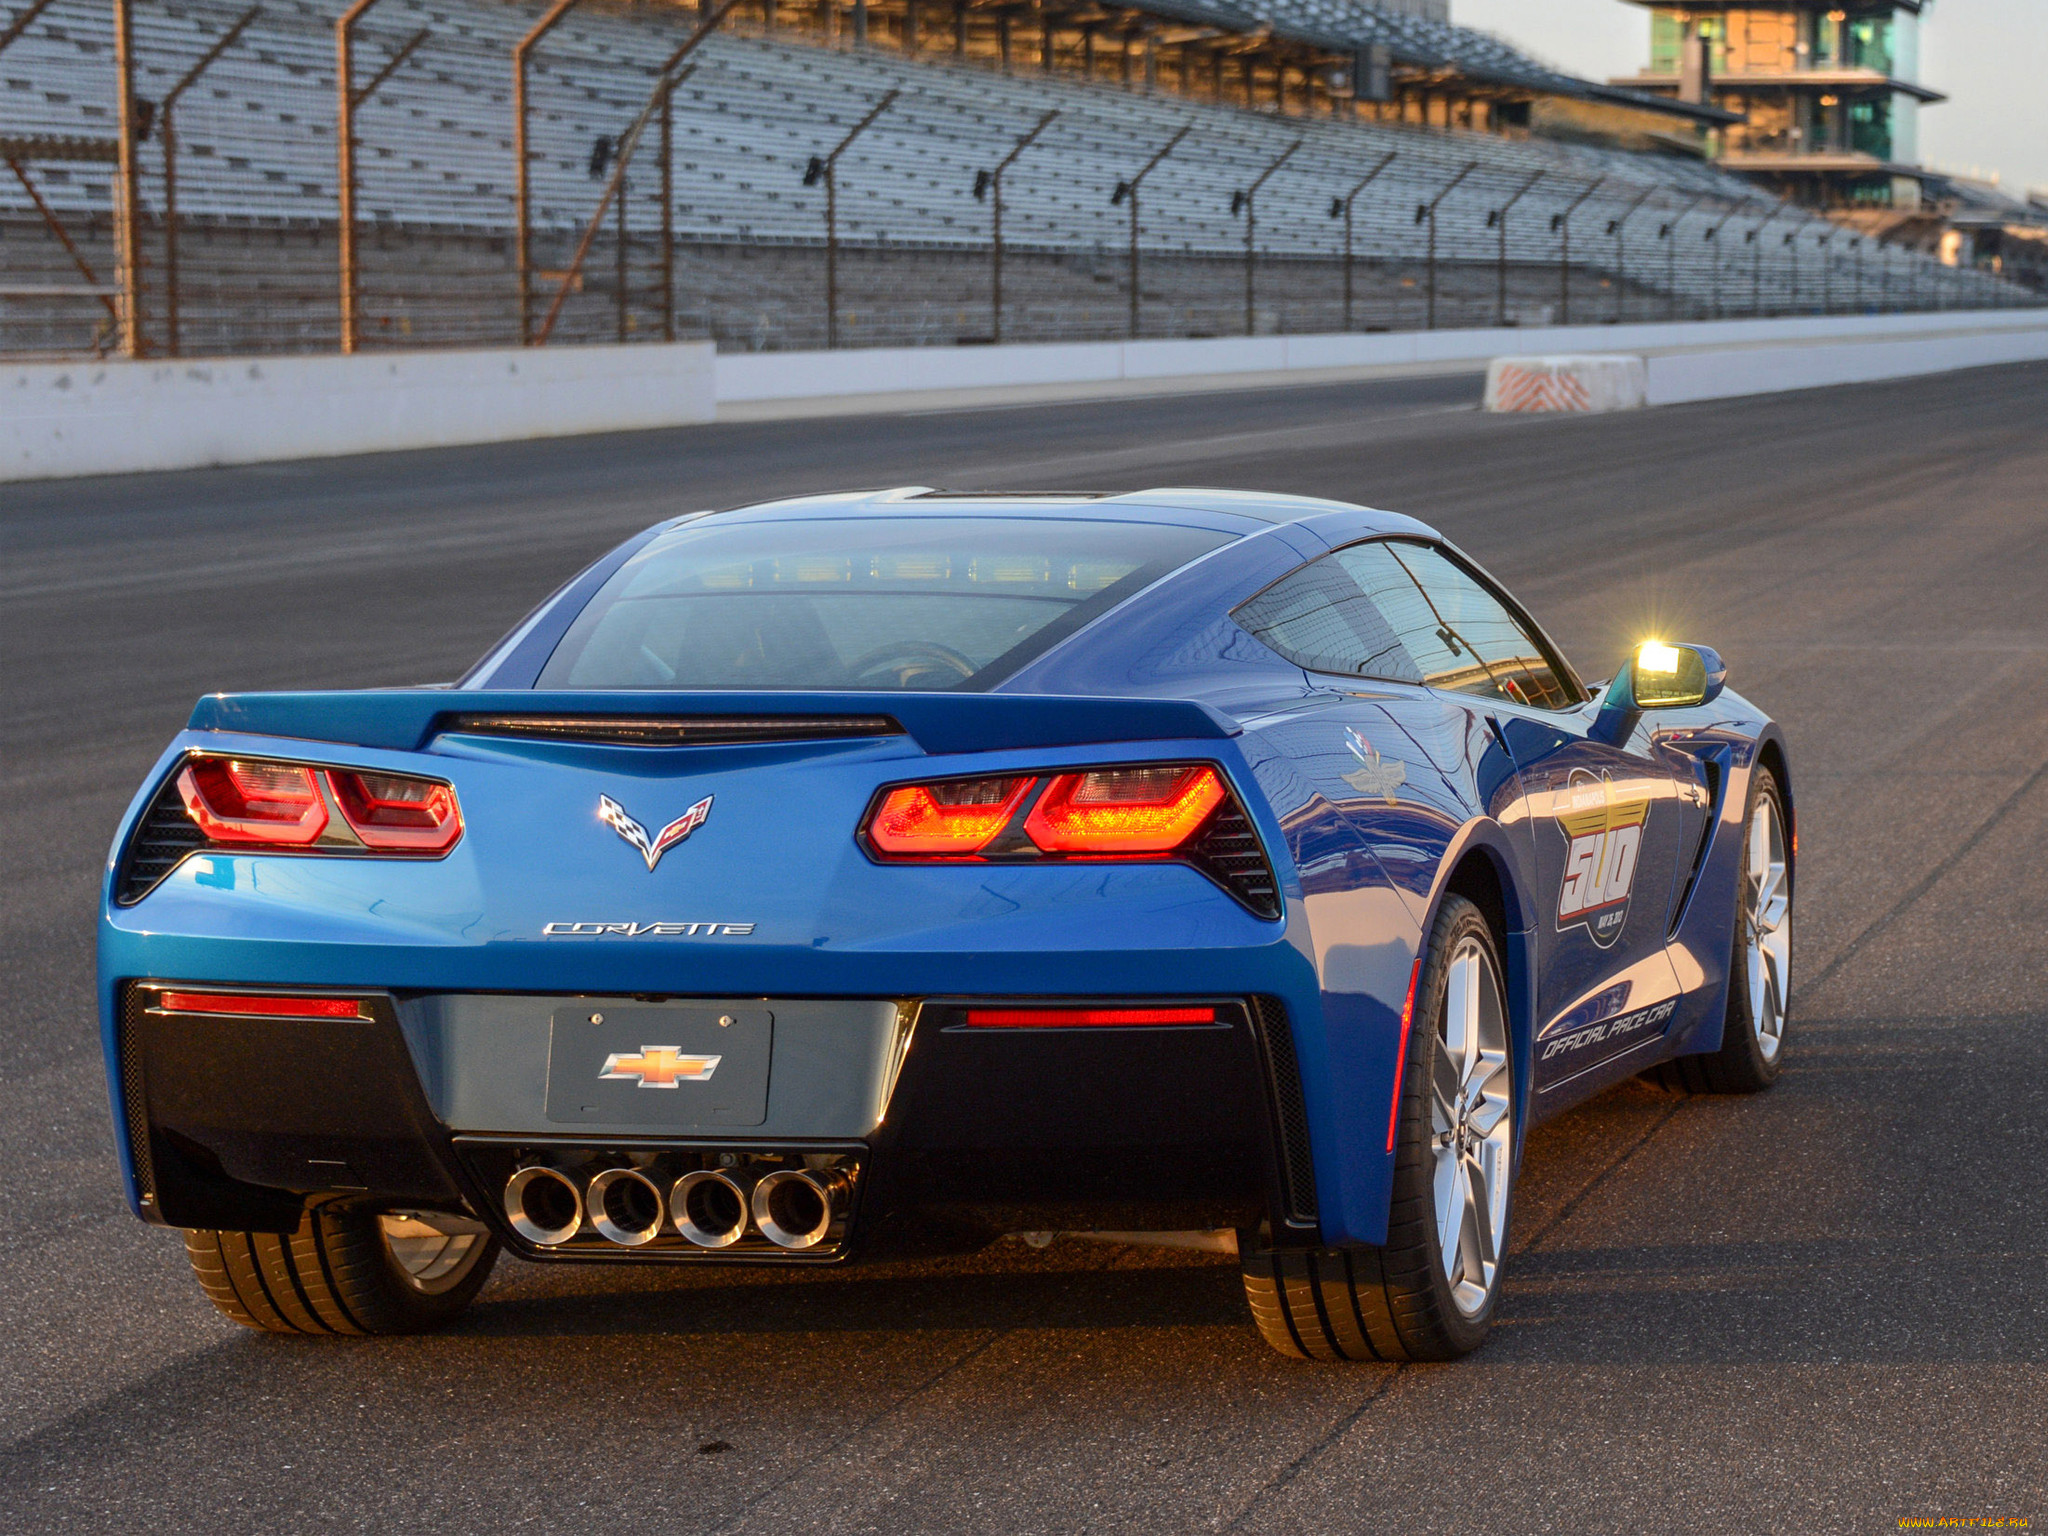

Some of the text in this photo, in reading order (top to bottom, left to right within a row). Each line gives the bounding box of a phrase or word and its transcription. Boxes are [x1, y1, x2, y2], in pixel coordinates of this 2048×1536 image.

[543, 921, 757, 936] CORVETTE
[1541, 1000, 1676, 1060] OFFICIAL PACE CAR
